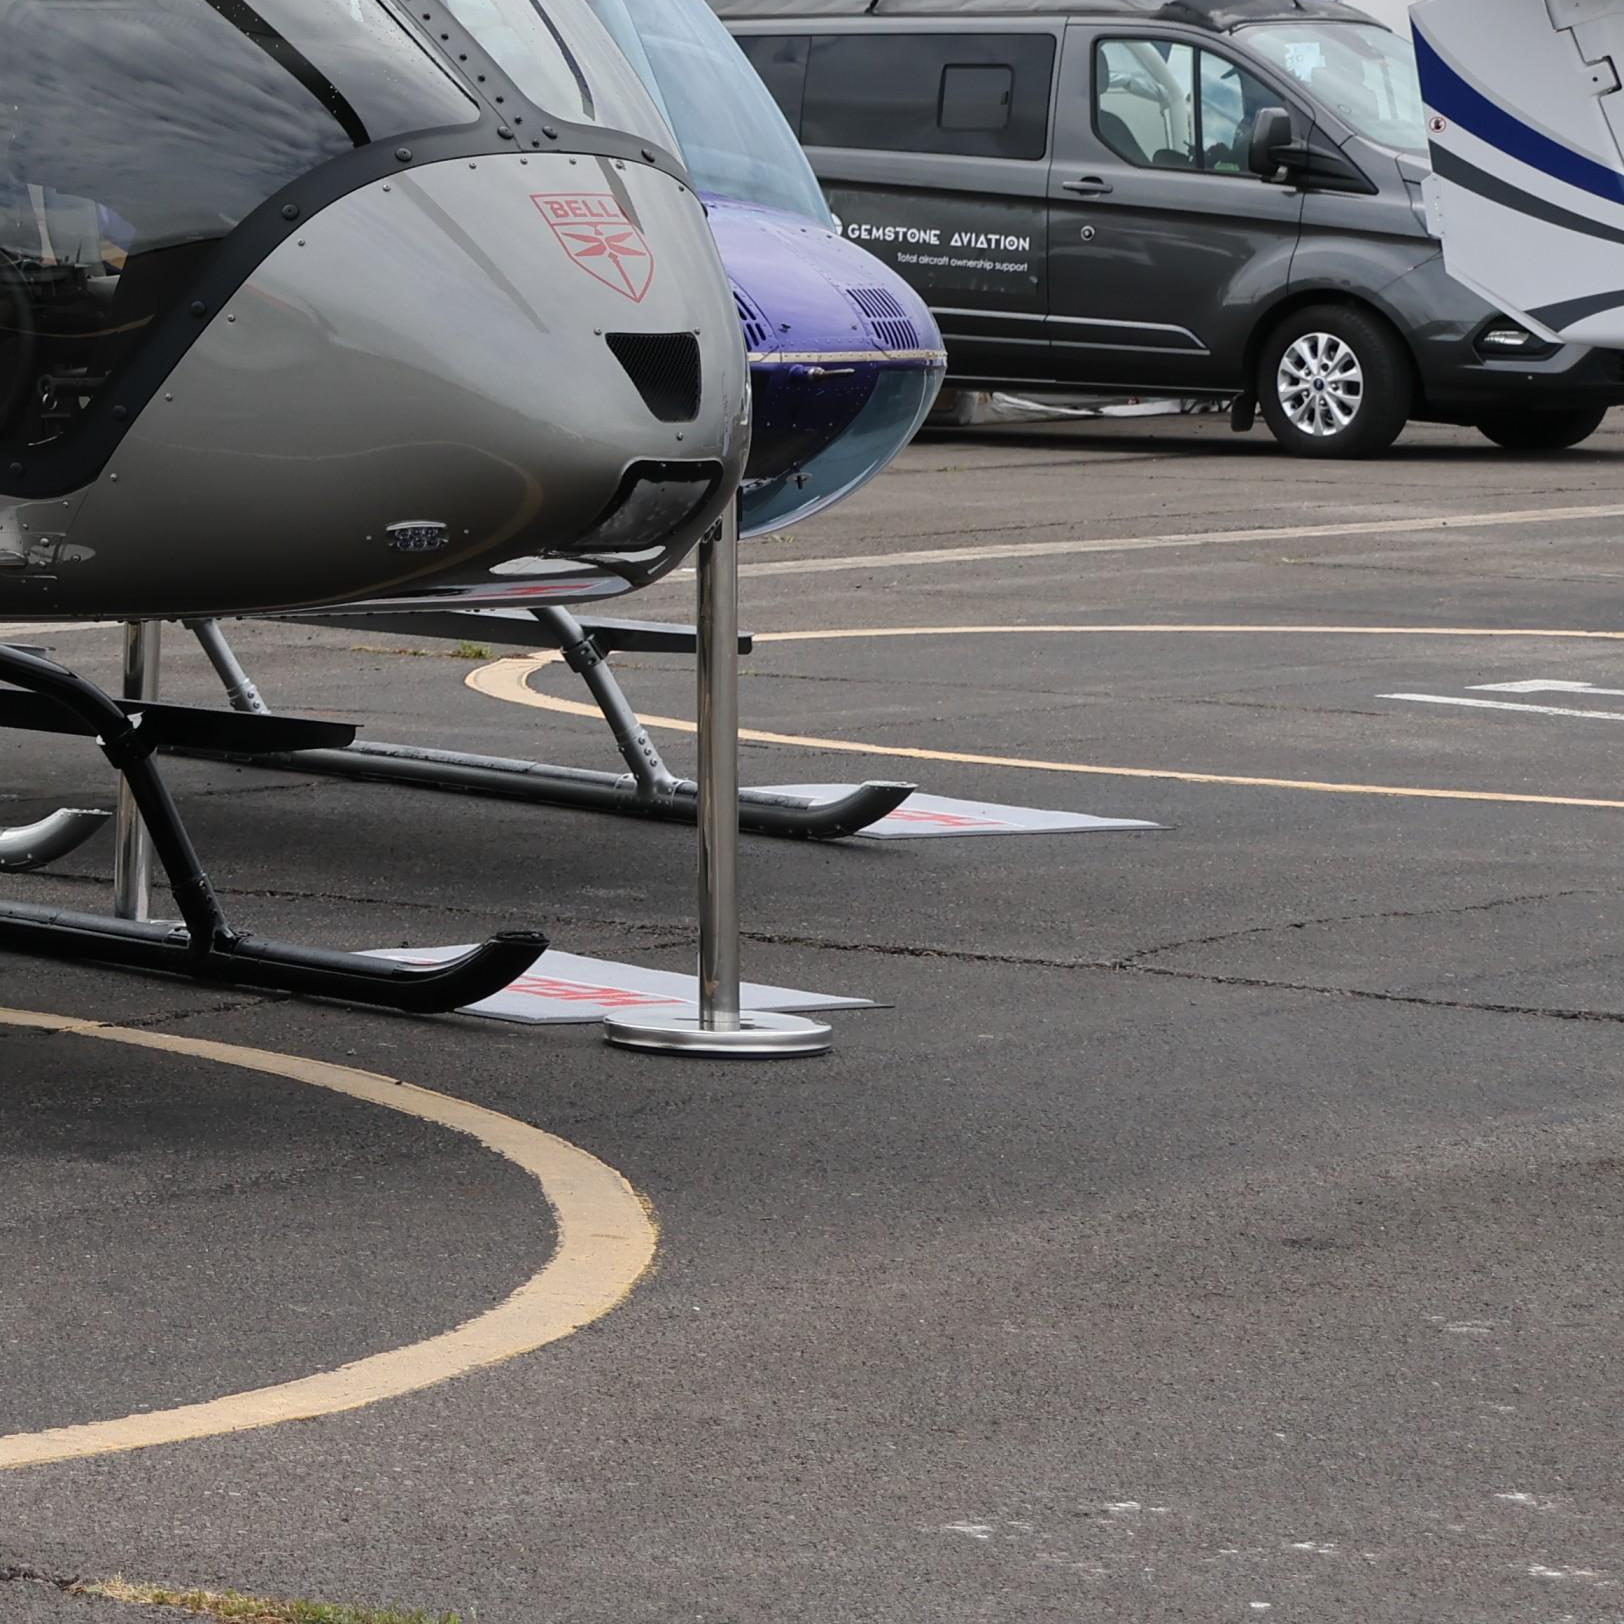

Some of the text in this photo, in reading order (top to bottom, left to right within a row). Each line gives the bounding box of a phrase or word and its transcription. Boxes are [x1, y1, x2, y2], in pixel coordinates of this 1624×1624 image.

[543, 199, 620, 217] BELL
[847, 223, 1030, 251] GEMSTONE AVIATION
[919, 254, 949, 266] aircraft
[950, 257, 994, 270] ownership
[994, 261, 1028, 273] support
